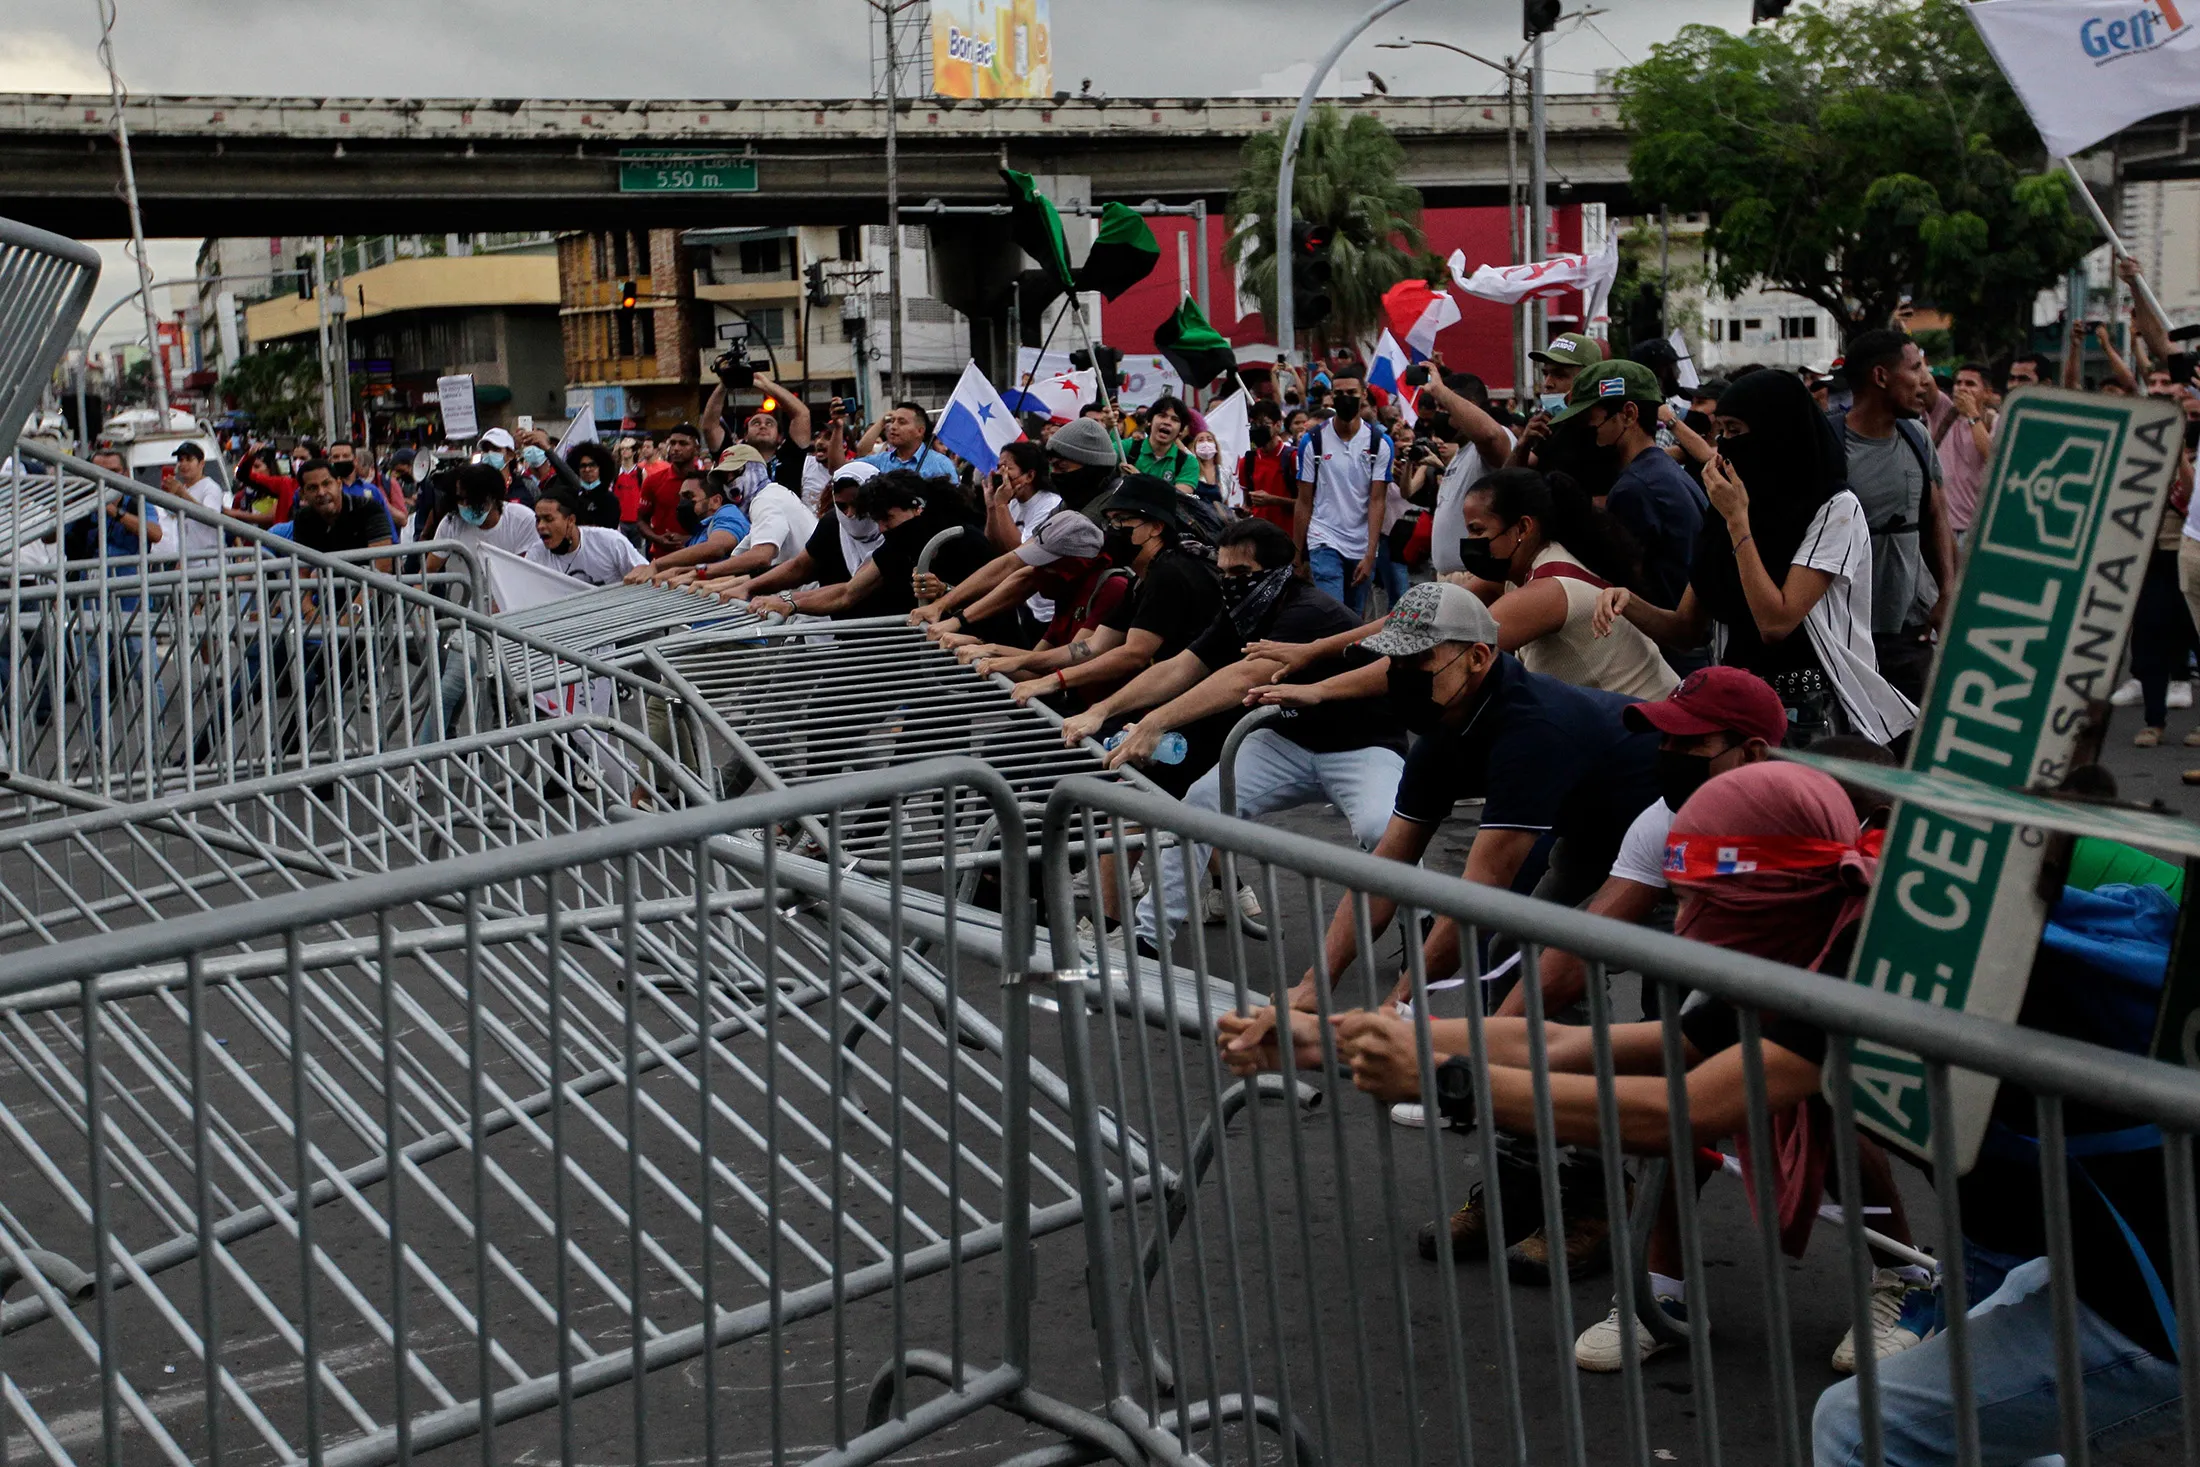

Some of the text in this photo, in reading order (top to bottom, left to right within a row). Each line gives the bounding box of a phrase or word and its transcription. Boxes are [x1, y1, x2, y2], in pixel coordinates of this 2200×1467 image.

[948, 26, 994, 67] Bonac
[656, 170, 695, 188] 5.50
[2052, 555, 2134, 738] SANTA
[2112, 415, 2178, 536] ANA
[1853, 957, 1956, 1127] AE.
